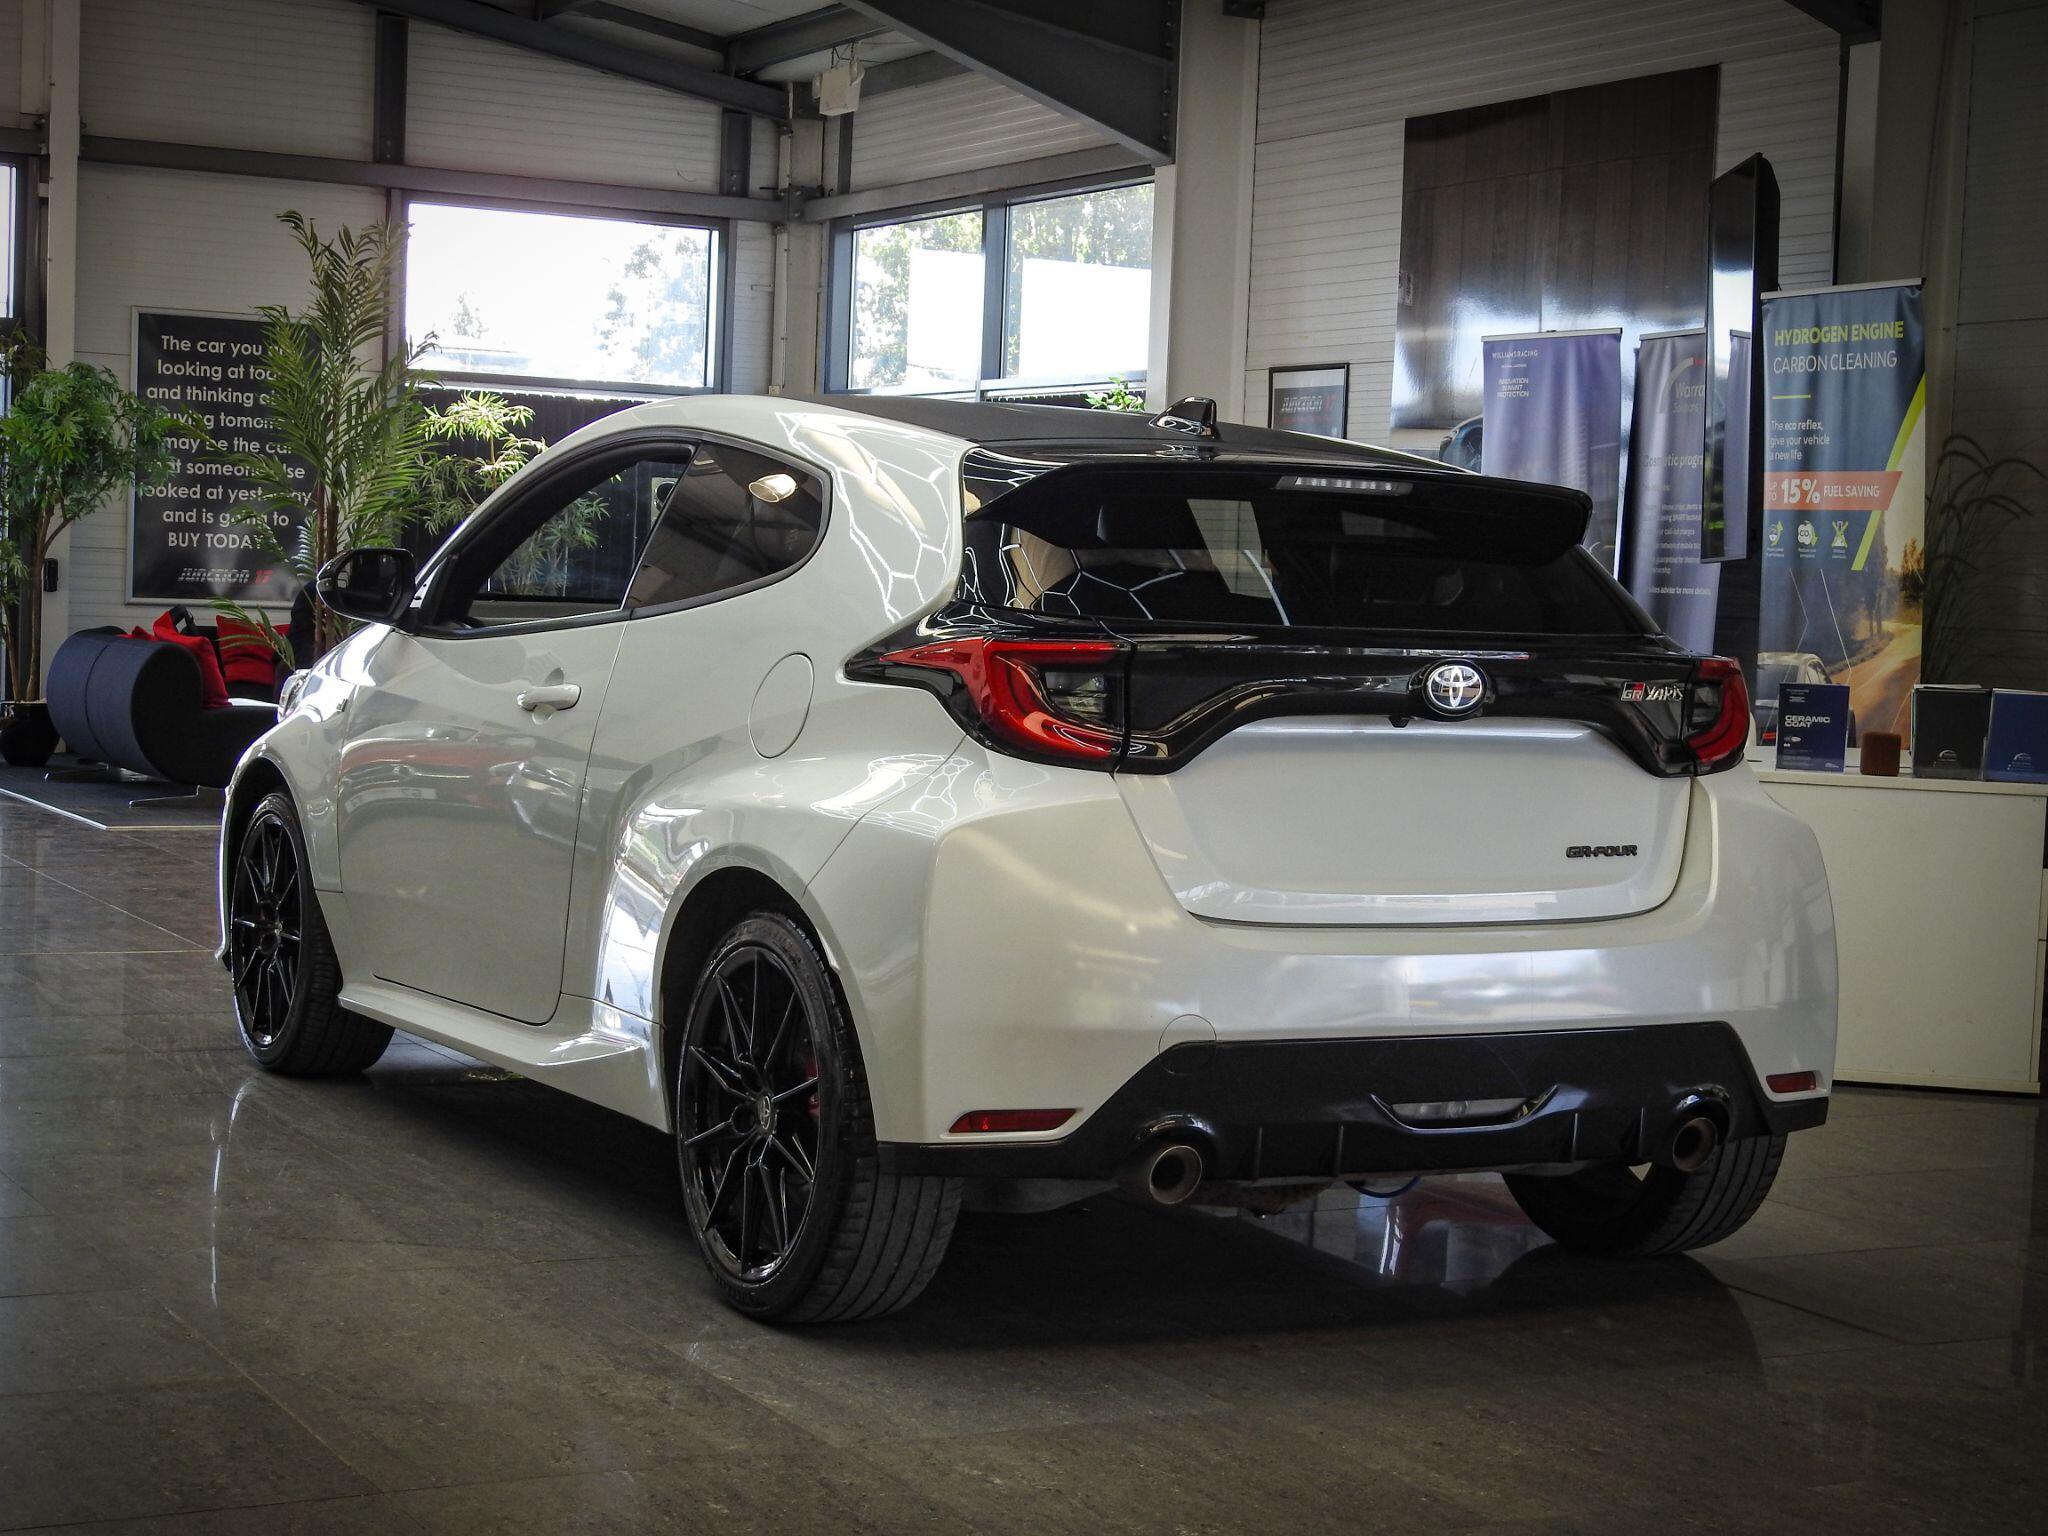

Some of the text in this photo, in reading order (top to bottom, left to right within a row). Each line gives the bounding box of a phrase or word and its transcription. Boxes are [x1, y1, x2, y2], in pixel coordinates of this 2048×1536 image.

[1774, 320, 1904, 347] HYDROGEN ENGINE
[161, 335, 192, 352] The
[196, 340, 226, 354] car
[230, 343, 262, 358] you
[157, 359, 222, 381] looking
[227, 364, 245, 379] at
[1773, 350, 1898, 374] CARBON CLEANING
[146, 385, 181, 400] and
[186, 385, 254, 407] thinking
[1674, 380, 1705, 399] Warra
[1771, 421, 1784, 431] The
[1784, 422, 1797, 431] eco
[233, 437, 260, 453] the
[1786, 436, 1802, 447] your
[1802, 433, 1831, 445] vehicle
[1680, 454, 1704, 469] progr
[1775, 451, 1790, 460] new
[1790, 449, 1803, 460] life
[282, 463, 307, 479] lse
[206, 485, 224, 500] at
[228, 486, 312, 507] yestay
[1781, 478, 1821, 504] 15%
[1823, 485, 1880, 498] FUEL SAVING
[163, 508, 197, 523] and
[202, 508, 214, 523] is
[273, 511, 290, 526] to
[168, 532, 201, 548] BUY
[1623, 689, 1642, 700] GR
[1784, 714, 1831, 723] CERAMIC
